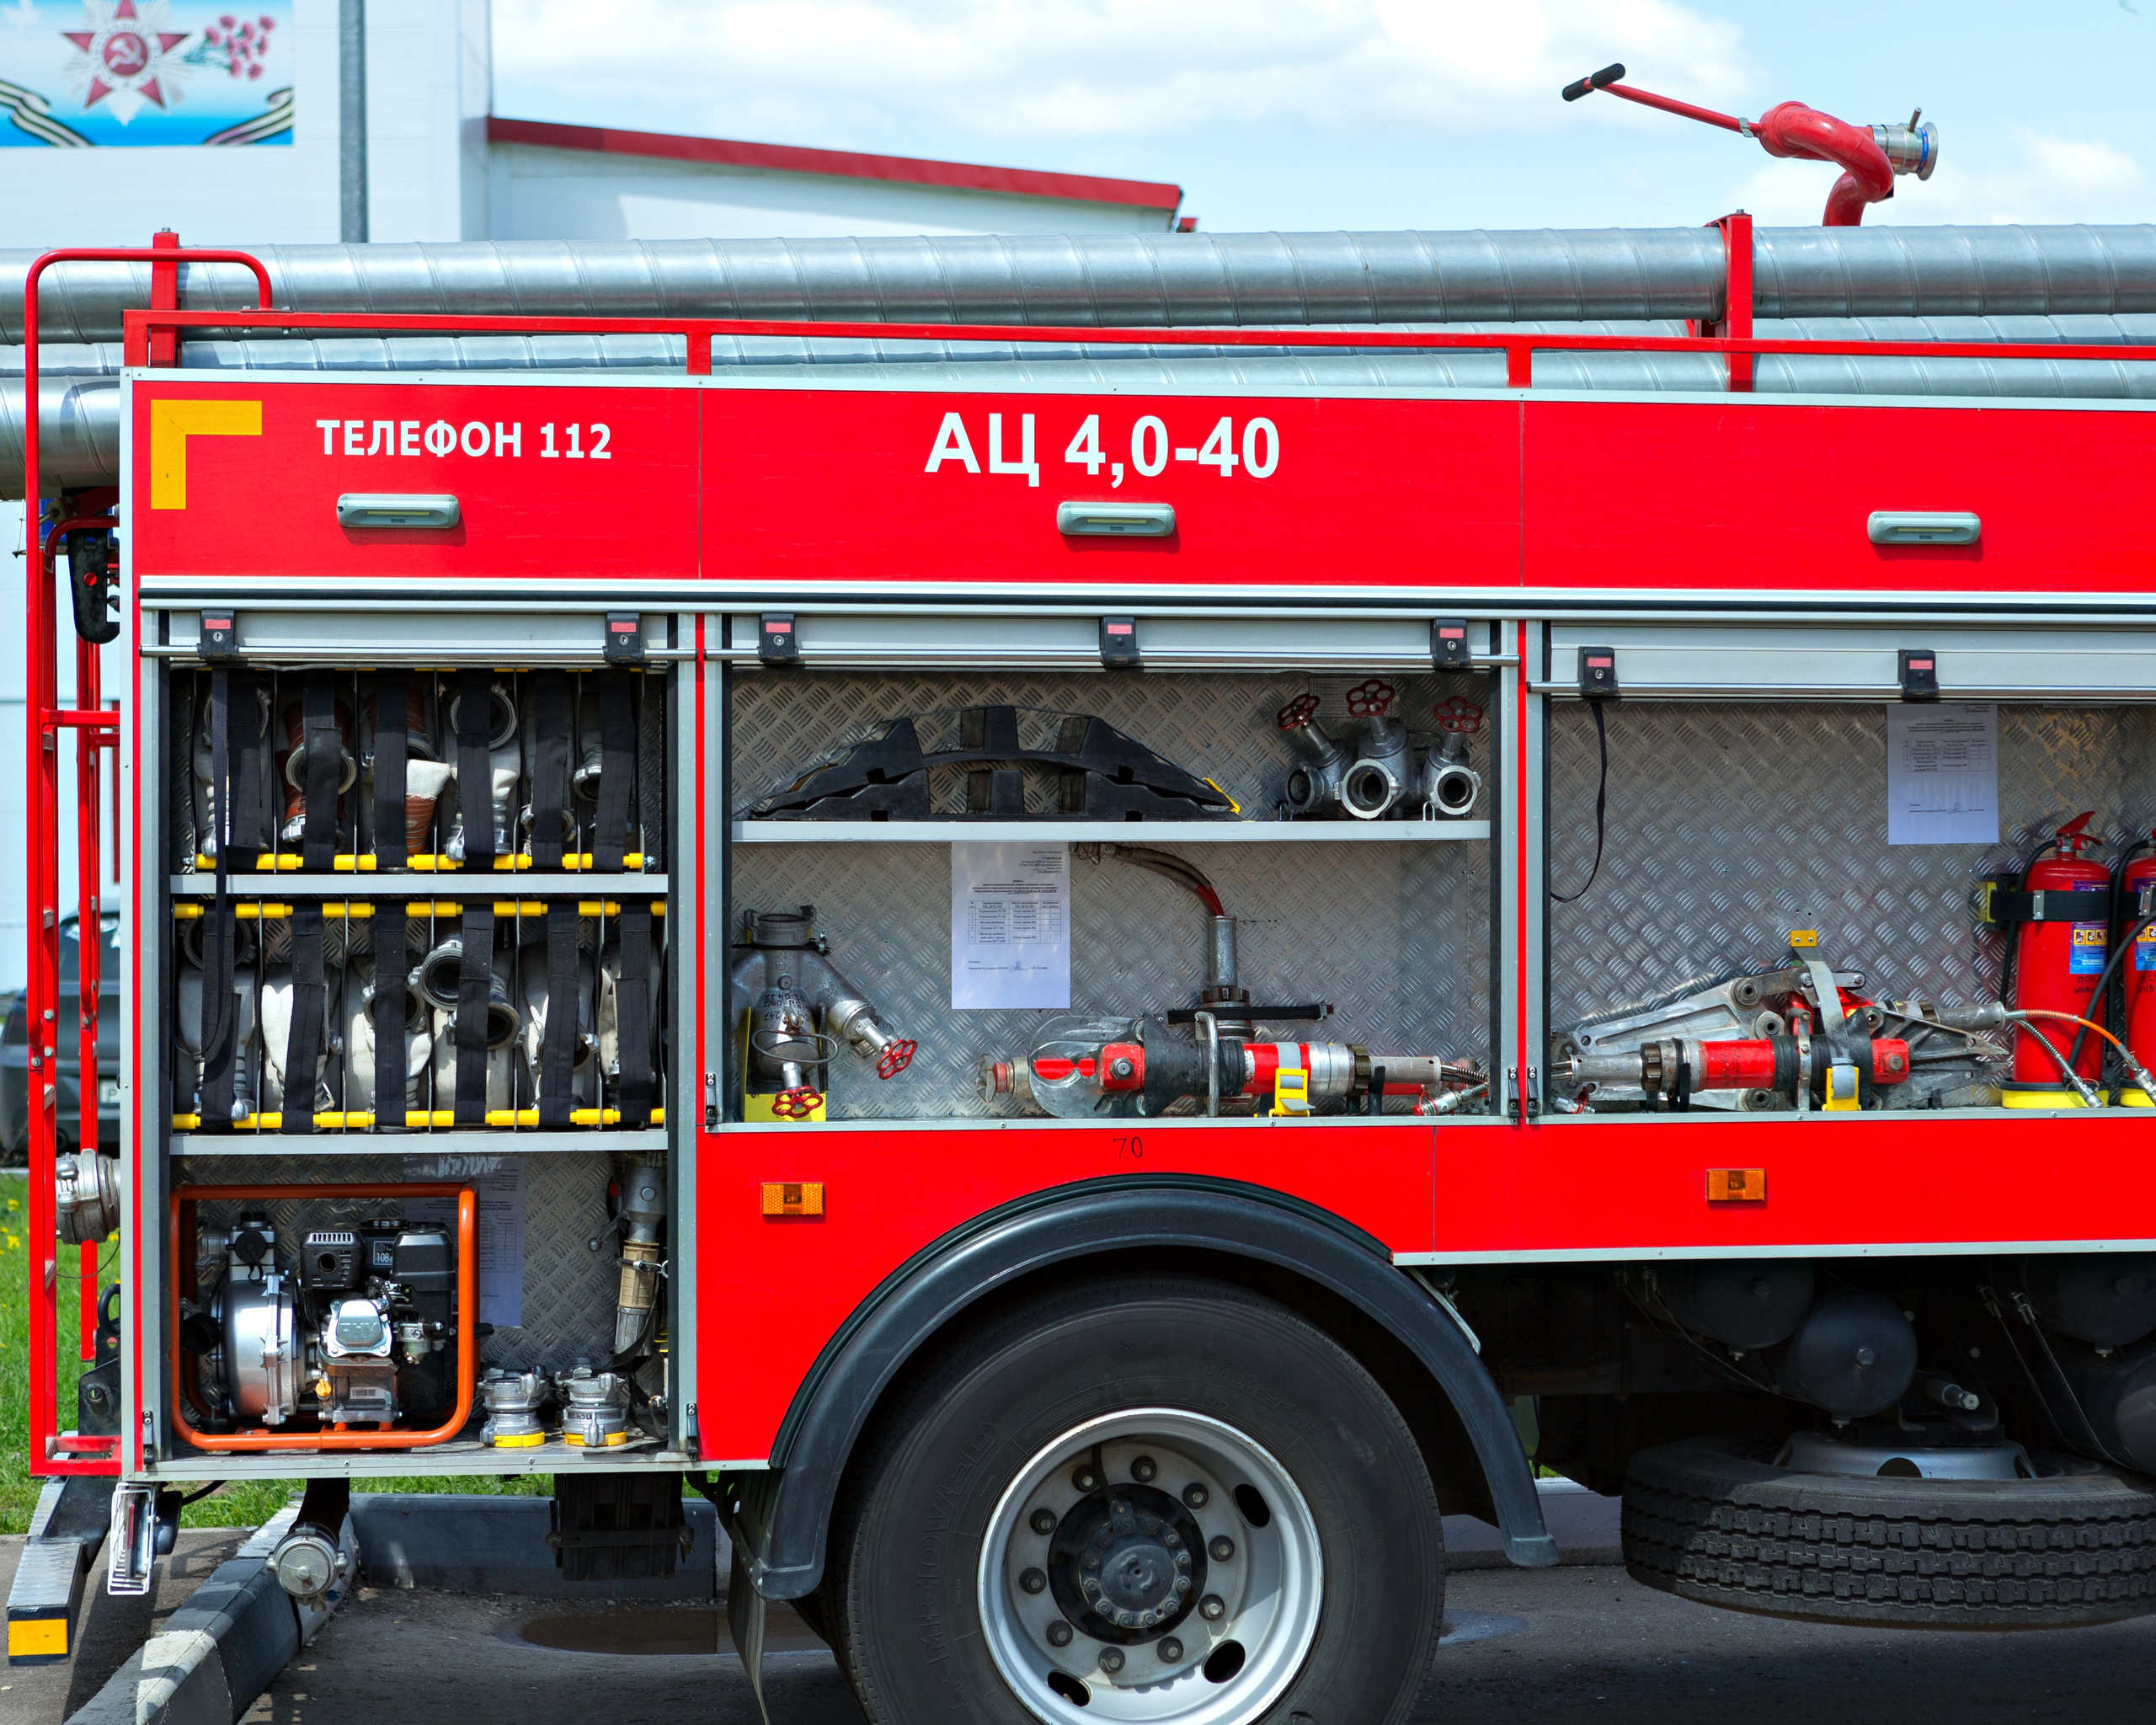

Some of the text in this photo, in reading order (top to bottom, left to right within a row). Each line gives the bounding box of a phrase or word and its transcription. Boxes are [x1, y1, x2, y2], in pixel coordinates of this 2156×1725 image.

[317, 419, 611, 459] ТЕЛЕФОН 112
[925, 412, 1280, 489] АЦ 4,0-40
[376, 1252, 389, 1263] 108
